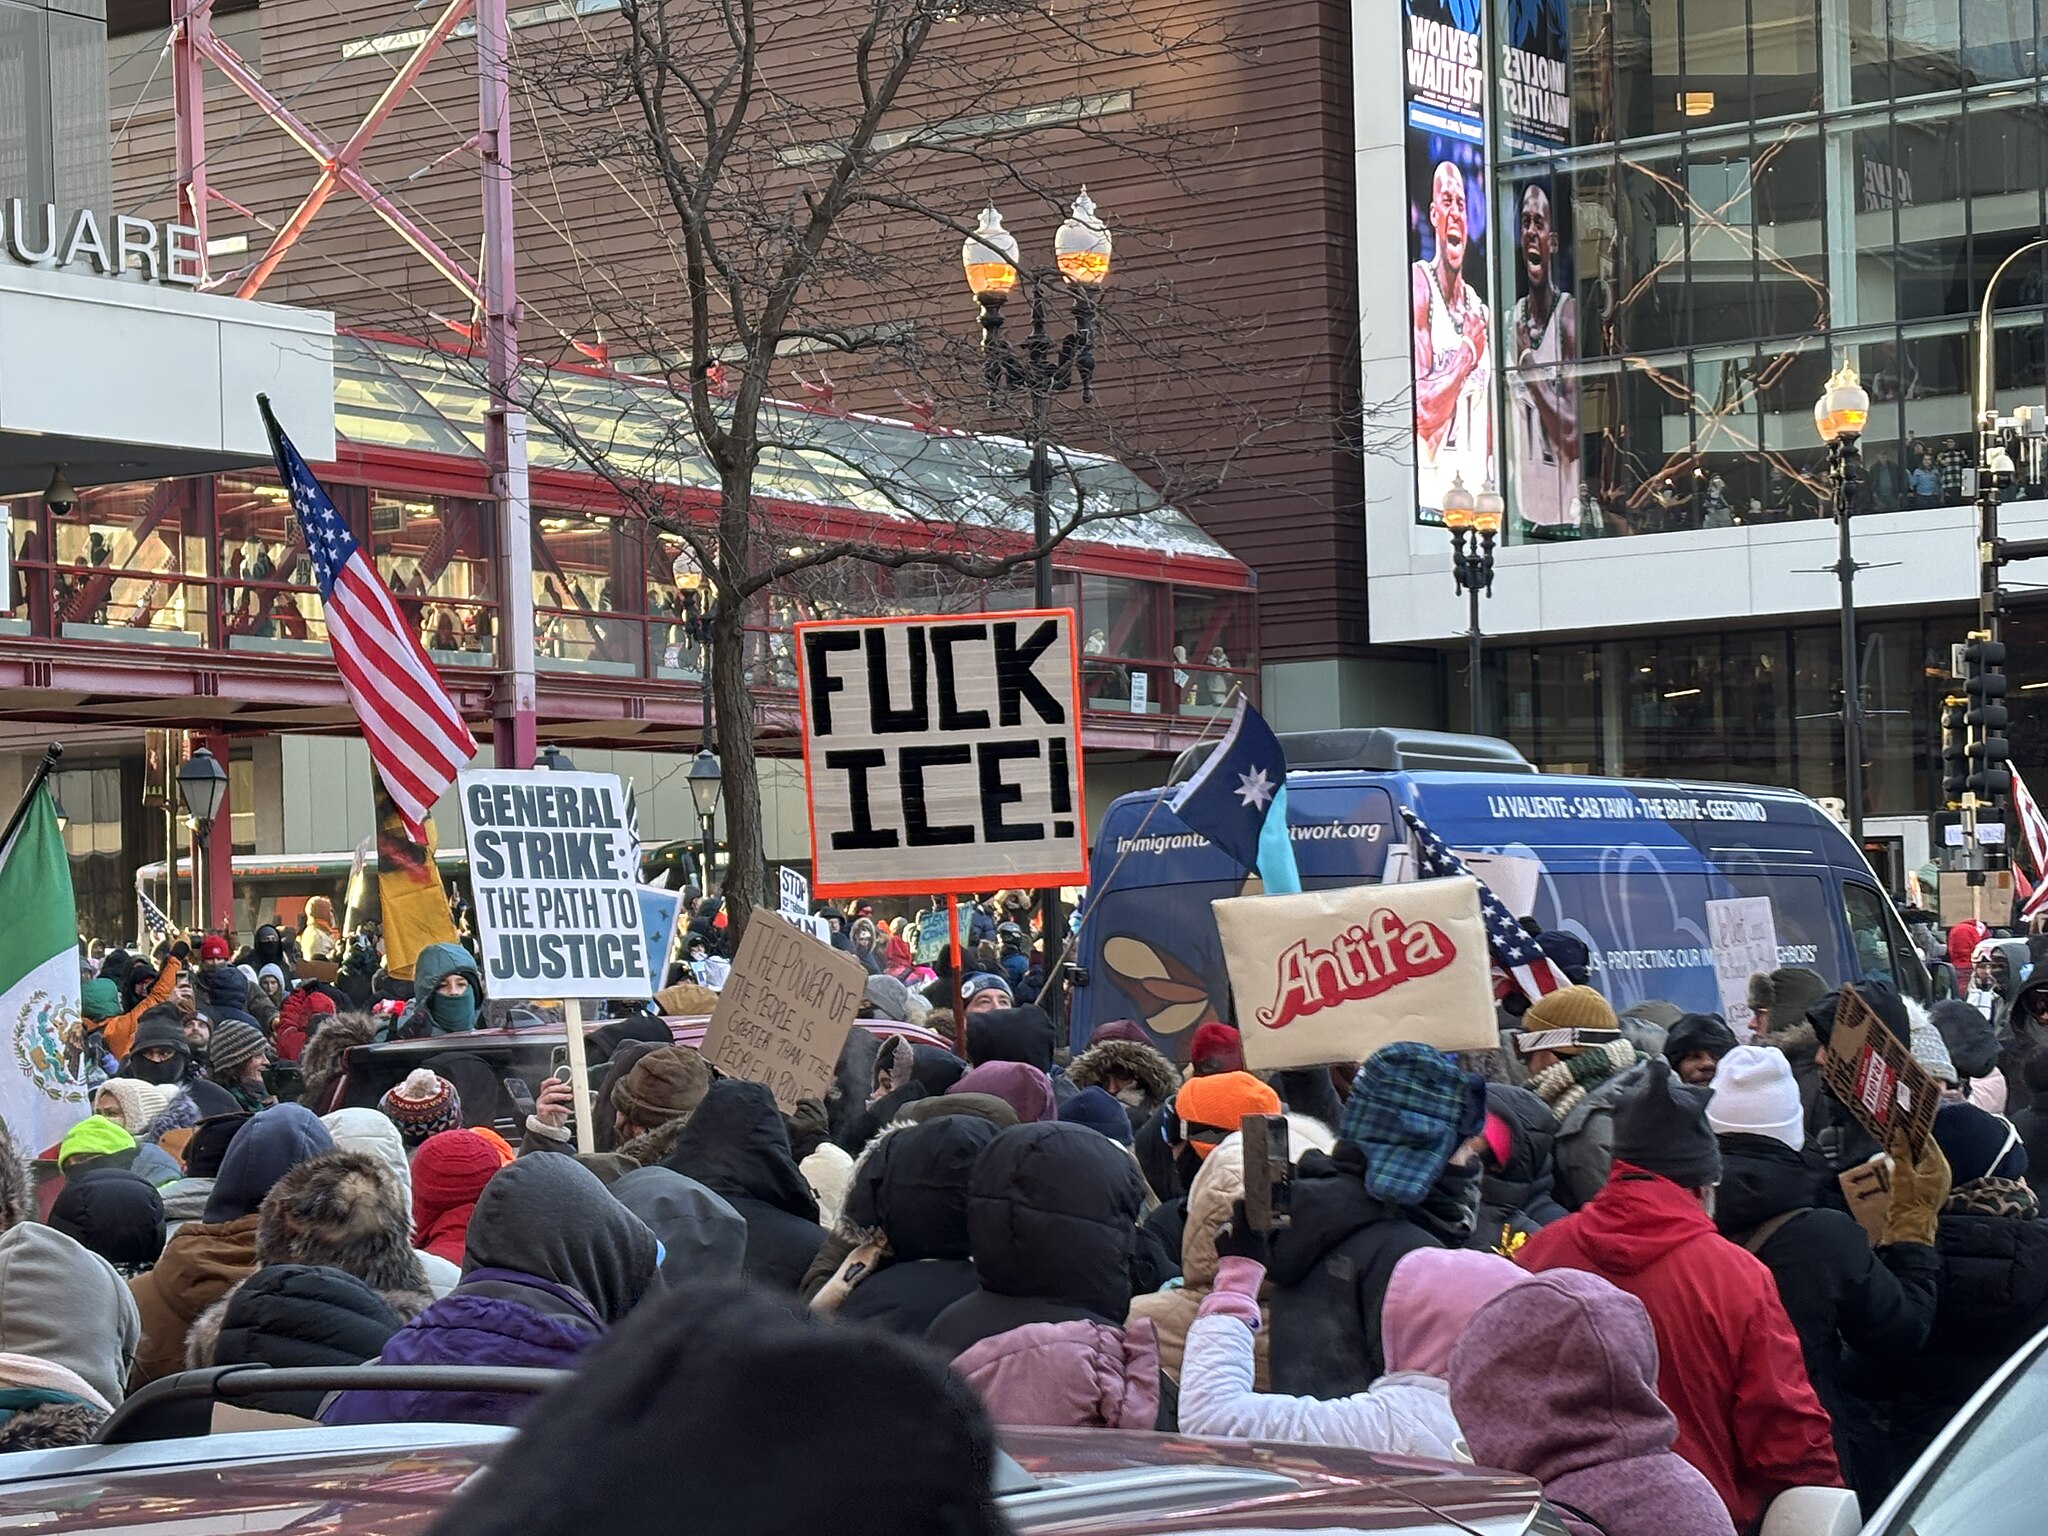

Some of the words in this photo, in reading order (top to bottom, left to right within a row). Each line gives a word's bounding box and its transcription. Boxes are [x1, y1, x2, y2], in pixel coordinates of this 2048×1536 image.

[1410, 14, 1479, 68] WOLVES
[1407, 49, 1483, 104] WAITLIST
[0, 197, 201, 285] UARE
[804, 619, 1066, 737] FUCK
[467, 784, 622, 829] GENERAL
[825, 737, 1075, 851] ICE!
[1505, 796, 1571, 818] VALIENTE
[1638, 798, 1666, 819] THE
[1662, 798, 1704, 820] BRAVE
[474, 829, 628, 880] STRIKE:
[480, 887, 534, 929] THE
[535, 887, 601, 929] PATH
[601, 888, 638, 929] TO
[782, 870, 806, 902] STOP
[490, 933, 645, 979] JUSTICE
[748, 920, 789, 982] THE
[775, 940, 834, 1009] POWER
[828, 982, 857, 1023] OF
[1256, 908, 1453, 1028] Antifa
[1607, 949, 1677, 971] PROTECTING
[1675, 948, 1701, 968] OUR
[731, 972, 757, 1012] THE
[754, 985, 797, 1032] PEOPLE
[798, 1017, 815, 1043] IS
[716, 1034, 764, 1081] PEOPLE
[762, 1065, 777, 1085] IN
[776, 1037, 807, 1067] THAN
[807, 1053, 833, 1082] THE
